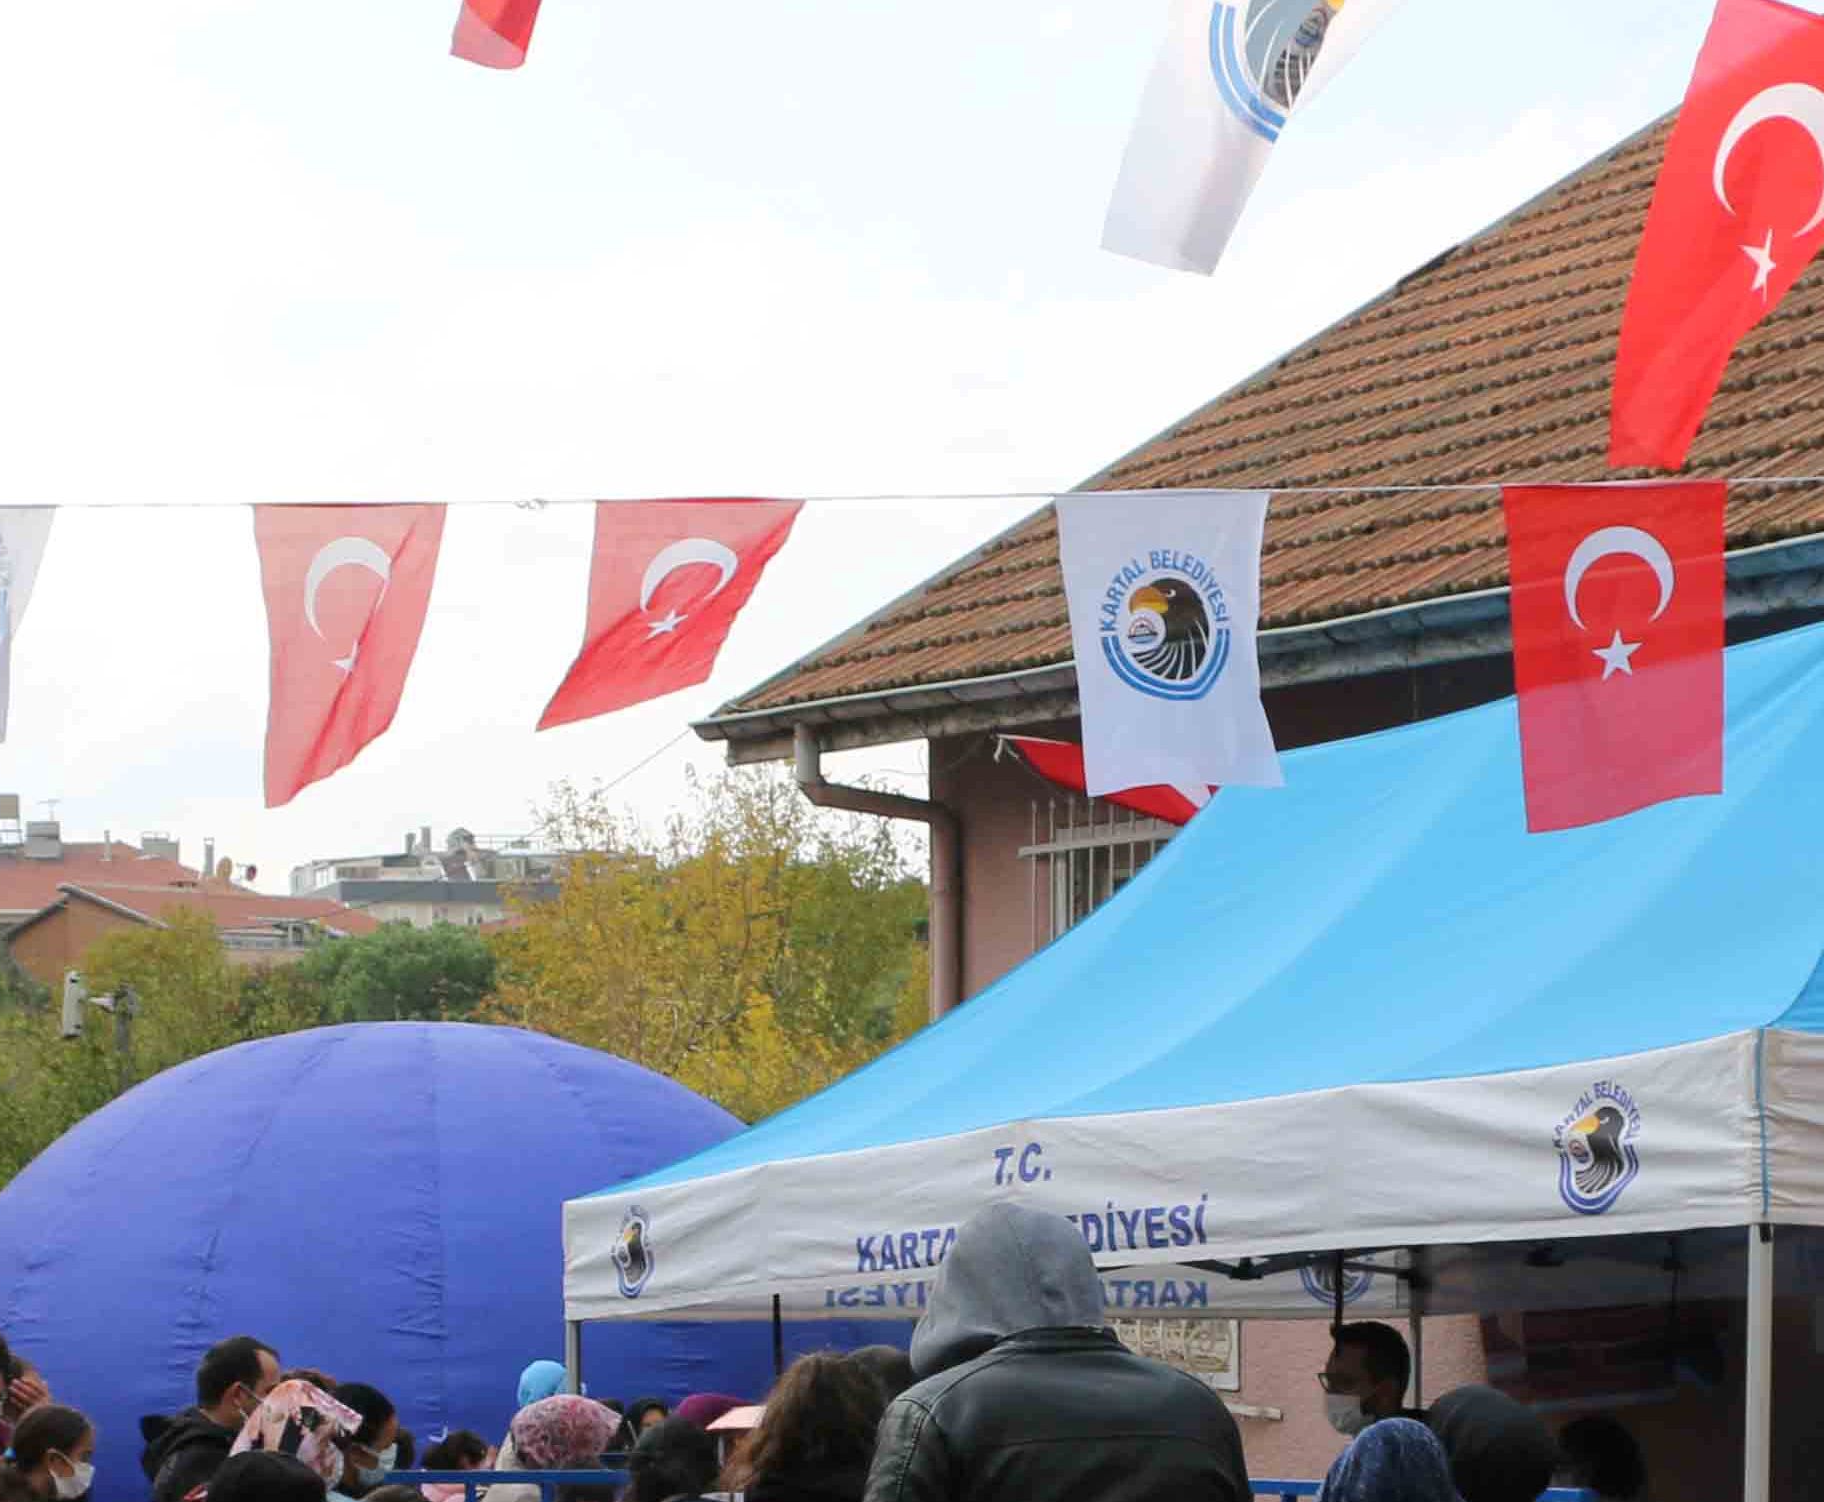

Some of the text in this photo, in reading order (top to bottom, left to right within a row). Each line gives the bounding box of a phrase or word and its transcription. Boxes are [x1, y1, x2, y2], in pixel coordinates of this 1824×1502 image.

[1099, 558, 1146, 632] KARTAL
[994, 1142, 1052, 1187] T.C.
[856, 1193, 1208, 1273] KARTA DİYESİ
